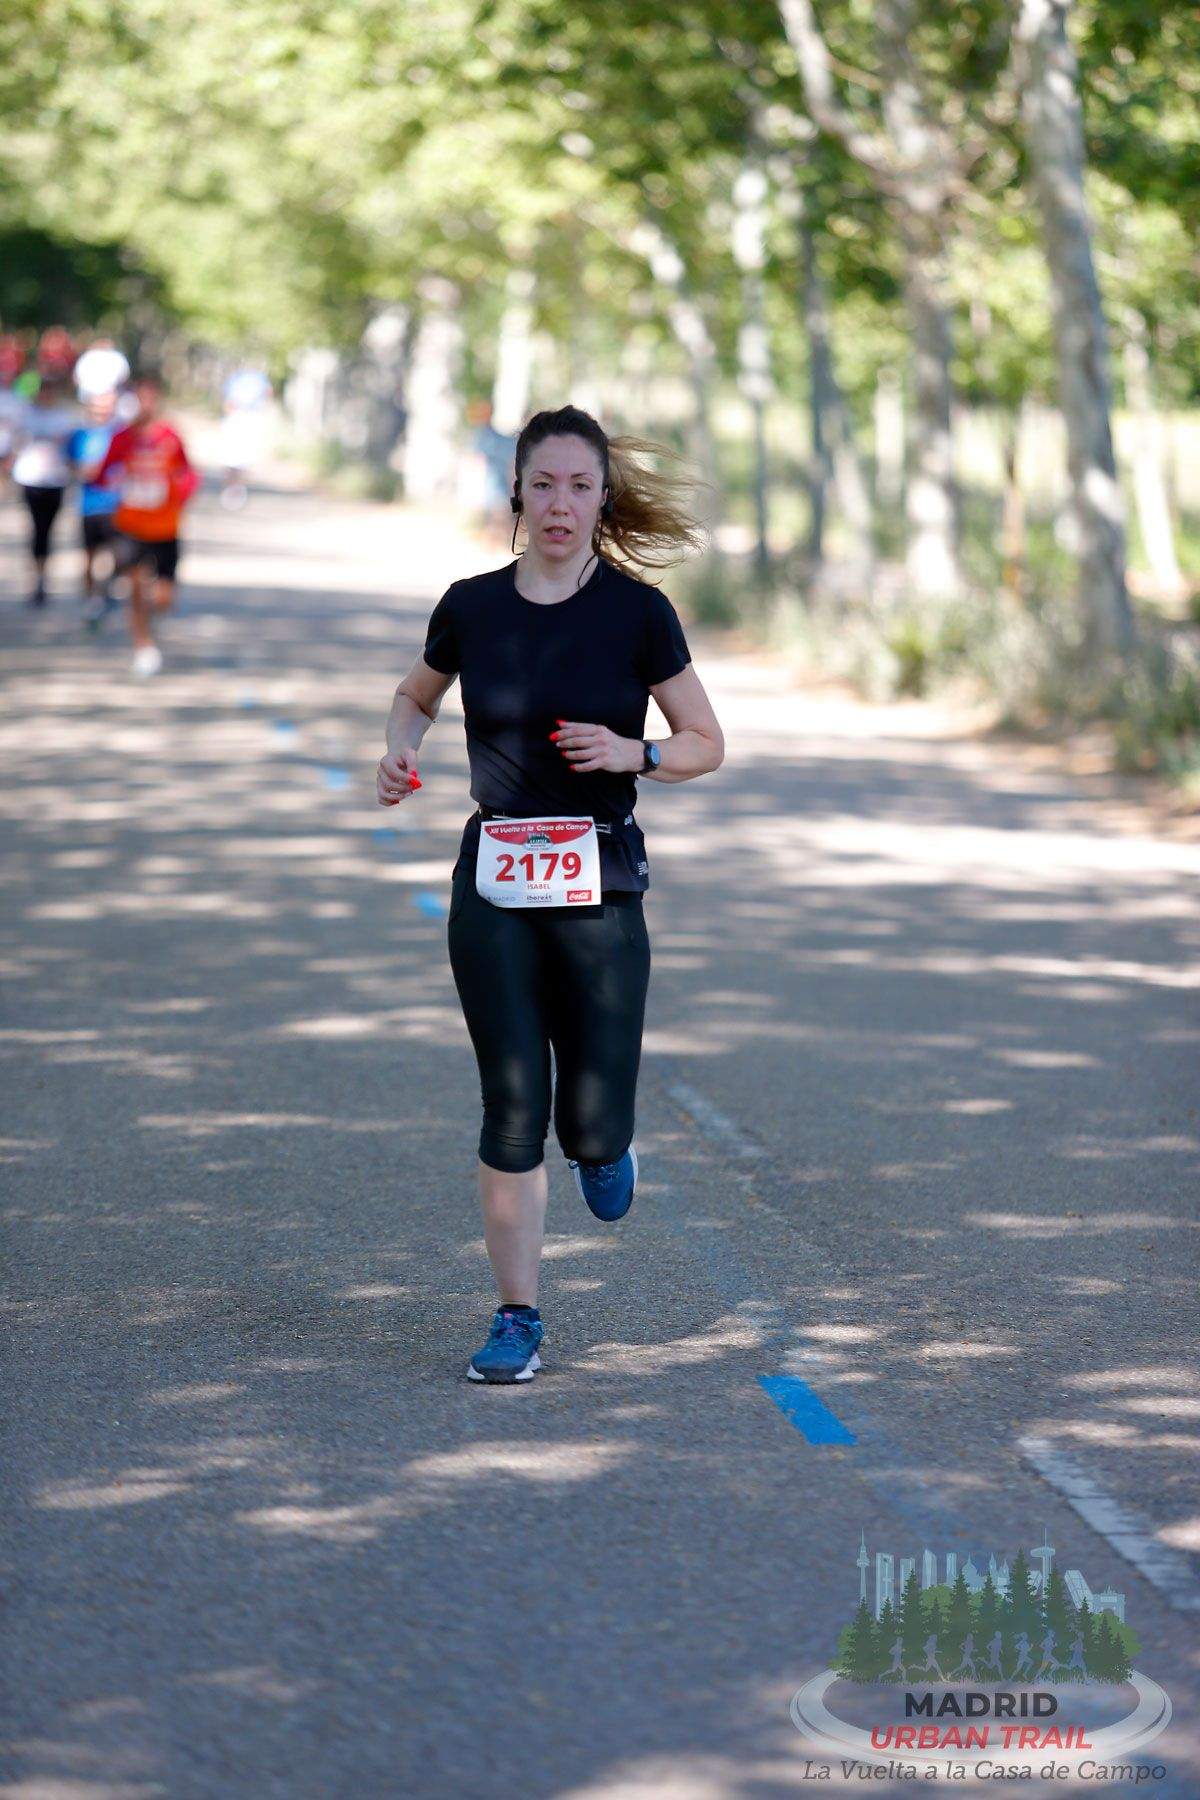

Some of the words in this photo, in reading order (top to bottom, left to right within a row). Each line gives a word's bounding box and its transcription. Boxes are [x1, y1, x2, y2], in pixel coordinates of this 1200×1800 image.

[536, 824, 554, 832] Casa
[566, 823, 589, 831] Campo
[495, 852, 582, 882] 2179
